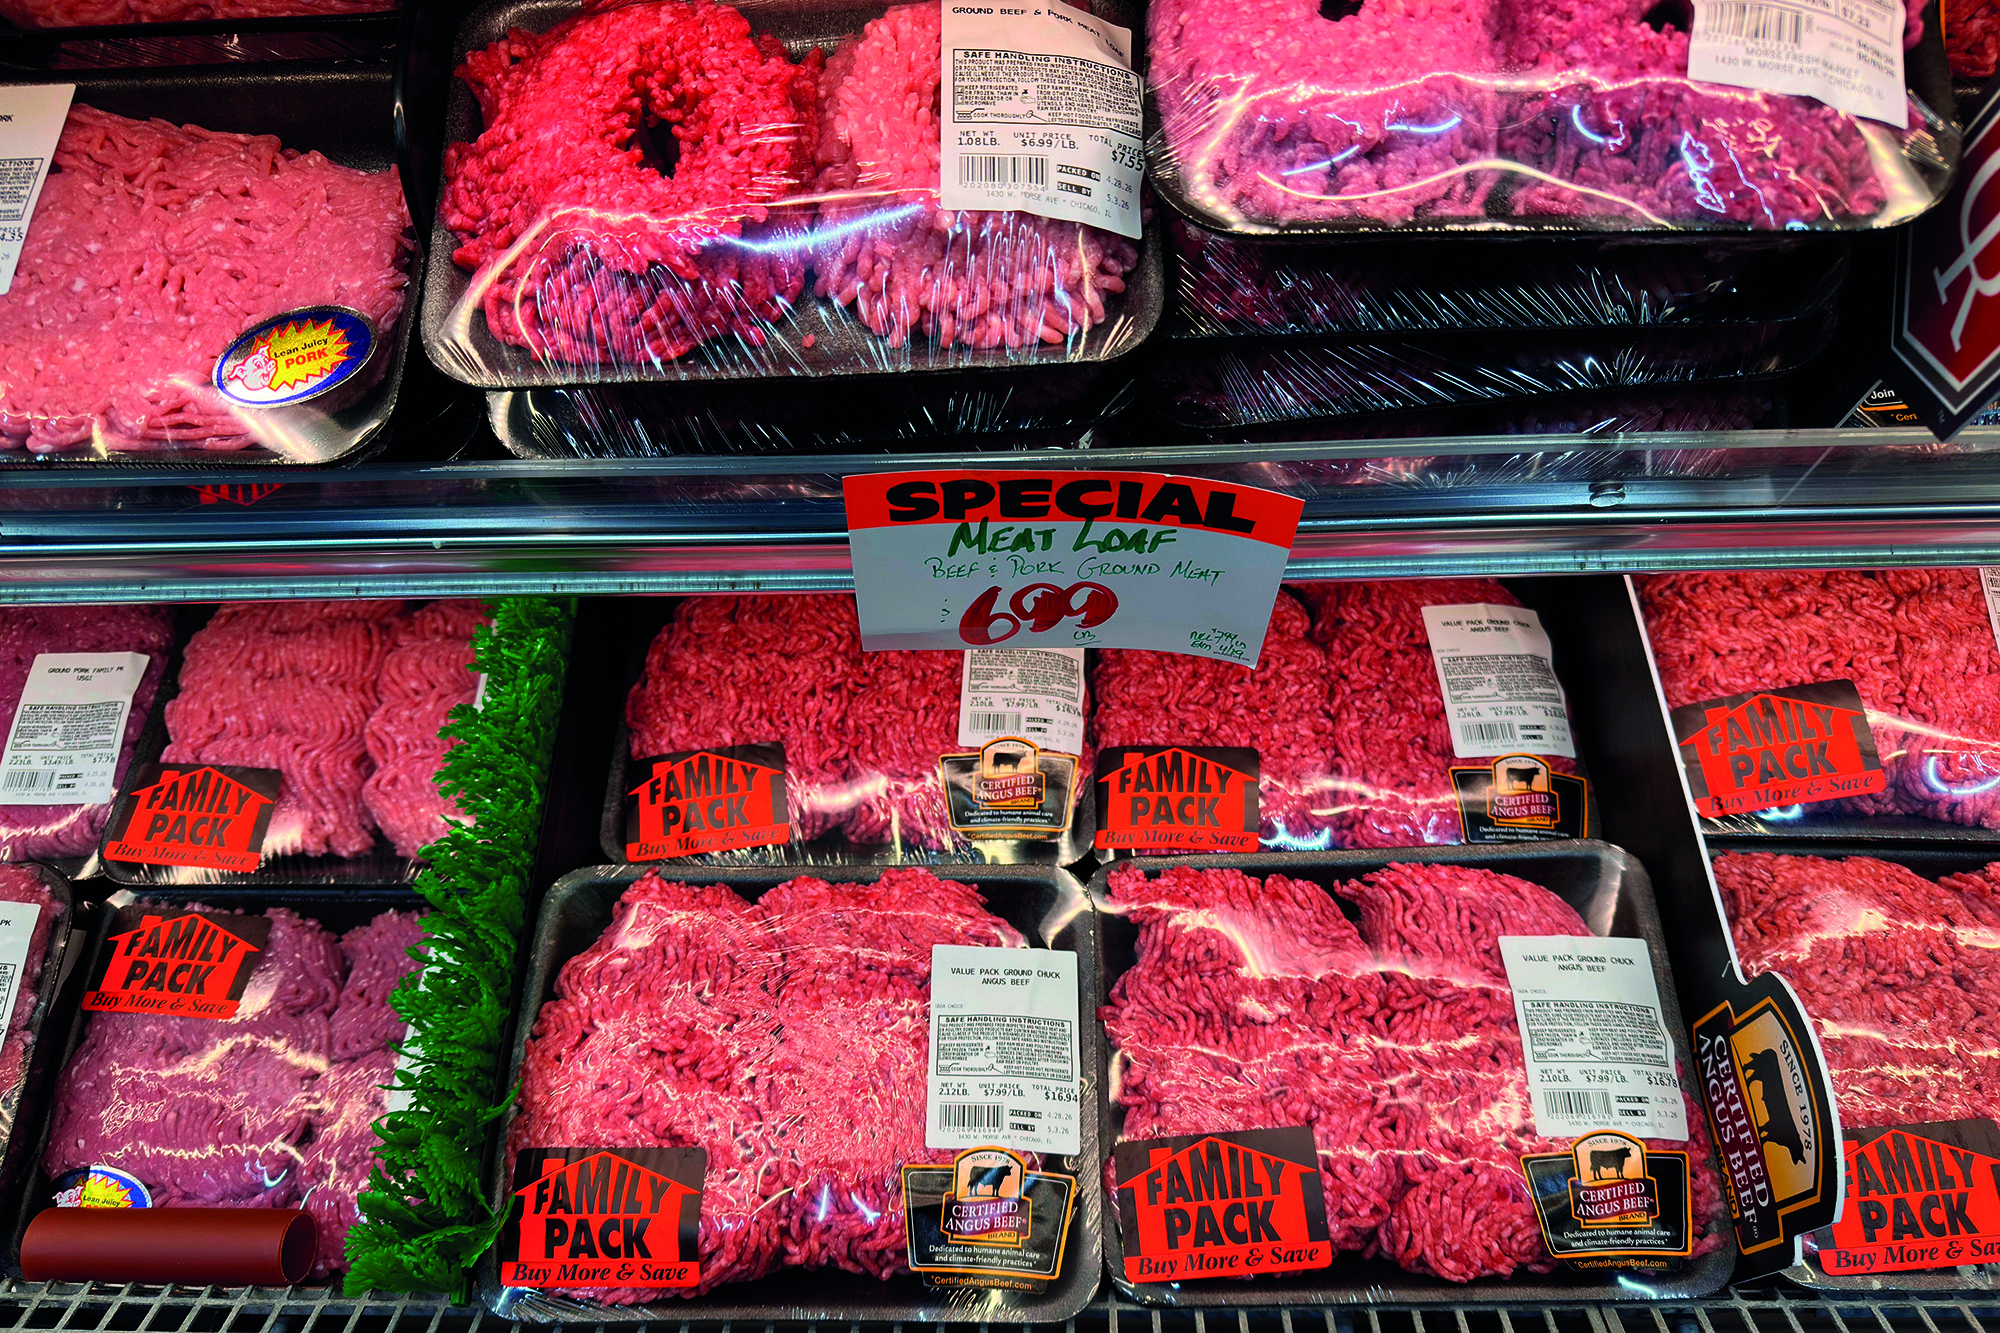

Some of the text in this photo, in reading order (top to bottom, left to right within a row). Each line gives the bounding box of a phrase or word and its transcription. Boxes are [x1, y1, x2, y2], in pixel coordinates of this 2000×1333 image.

[952, 7, 994, 15] GROUND
[1000, 8, 1027, 16] BEEF
[1047, 9, 1073, 24] PORK
[1077, 22, 1101, 38] MEAT
[1105, 38, 1125, 58] LOAF
[963, 51, 1131, 80] SAFE HANDLING INSTRUCTIONS
[1089, 134, 1113, 148] TOTAL
[1117, 143, 1143, 158] PRICE
[1111, 149, 1145, 172] $7.55
[1056, 165, 1101, 181] PACKED ON
[1106, 175, 1133, 194] 4.28.26
[1056, 183, 1078, 194] SELL
[1106, 193, 1130, 211] 5.3.26
[274, 337, 328, 359] Lean Juicy
[285, 347, 329, 369] PORK
[1870, 389, 1895, 400] Join
[886, 479, 1256, 534] SPECIAL
[947, 516, 1177, 558] MEAT LOAF
[924, 556, 980, 580] BEEF
[1006, 554, 1065, 579] PORK
[1077, 556, 1161, 580] GROUND
[1169, 560, 1226, 587] MEAT
[47, 667, 71, 675] GROUND
[92, 666, 114, 674] FAMILY
[1706, 696, 1835, 756] FAMILY
[1119, 751, 1233, 794] FAMILY
[1728, 740, 1838, 789] PACK
[650, 755, 759, 805] FAMILY
[980, 775, 1035, 791] CERTIFIED
[146, 770, 254, 815] FAMILY
[977, 785, 1038, 801] ANGUS BEEF
[1495, 794, 1549, 807] CERTIFIED
[1710, 774, 1874, 813] Buy More & Save
[662, 795, 751, 837] PACK
[1130, 796, 1221, 828] PACK
[1490, 804, 1553, 817] ANGUS BEEF
[145, 813, 235, 848] PACK
[1104, 829, 1249, 847] Buy More & Save
[114, 842, 250, 867] Buy More & Save
[636, 829, 780, 858] Buy More & Save
[124, 916, 239, 963] FAMILY
[1522, 954, 1635, 966] VALUE PACK GROUND CHUCK
[1558, 964, 1606, 973] ANGUS BEEF
[121, 959, 217, 995] PACK
[951, 967, 1061, 979] VALUE PACK GROUND CHUCK
[981, 977, 1030, 986] ANGUS BEEF
[90, 991, 229, 1015] Buy More & Save
[1044, 1091, 1078, 1103] $16.94
[1780, 1039, 1813, 1151] SINCE 1978
[1699, 1033, 1758, 1224] ANGUS BEEF
[1714, 1035, 1770, 1208] CERTIFIED
[1587, 1137, 1628, 1147] SINCE 1978
[971, 1154, 1010, 1165] SINCE 1978
[1844, 1133, 1976, 1199] FAMILY
[1146, 1140, 1286, 1206] FAMILY
[1715, 1144, 1738, 1215] BRAND
[533, 1155, 672, 1215] FAMILY
[1579, 1182, 1645, 1203] CERTIFIED
[83, 1194, 100, 1204] Lean
[102, 1198, 121, 1207] Juicy
[952, 1201, 1019, 1218] CERTIFIED
[1576, 1196, 1651, 1217] ANGUS BEEF
[945, 1216, 1023, 1232] ANGUS BEEF
[1164, 1200, 1282, 1250] PACK
[1618, 1212, 1645, 1222] BRAND
[1858, 1192, 1980, 1243] PACK
[545, 1218, 653, 1259] PACK
[987, 1232, 1016, 1240] BRAND
[1563, 1228, 1671, 1239] Dedicated humane animal care
[1571, 1239, 1584, 1248] and
[1584, 1236, 1635, 1248] climate-friendly
[929, 1245, 1040, 1259] Dedicated humane animal care
[935, 1254, 948, 1262] and
[949, 1254, 1002, 1266] climate-friendly
[1138, 1246, 1319, 1279] Buy More & Save
[1835, 1239, 2000, 1271] Buy More & Sav
[512, 1263, 688, 1285] Buy More & Save
